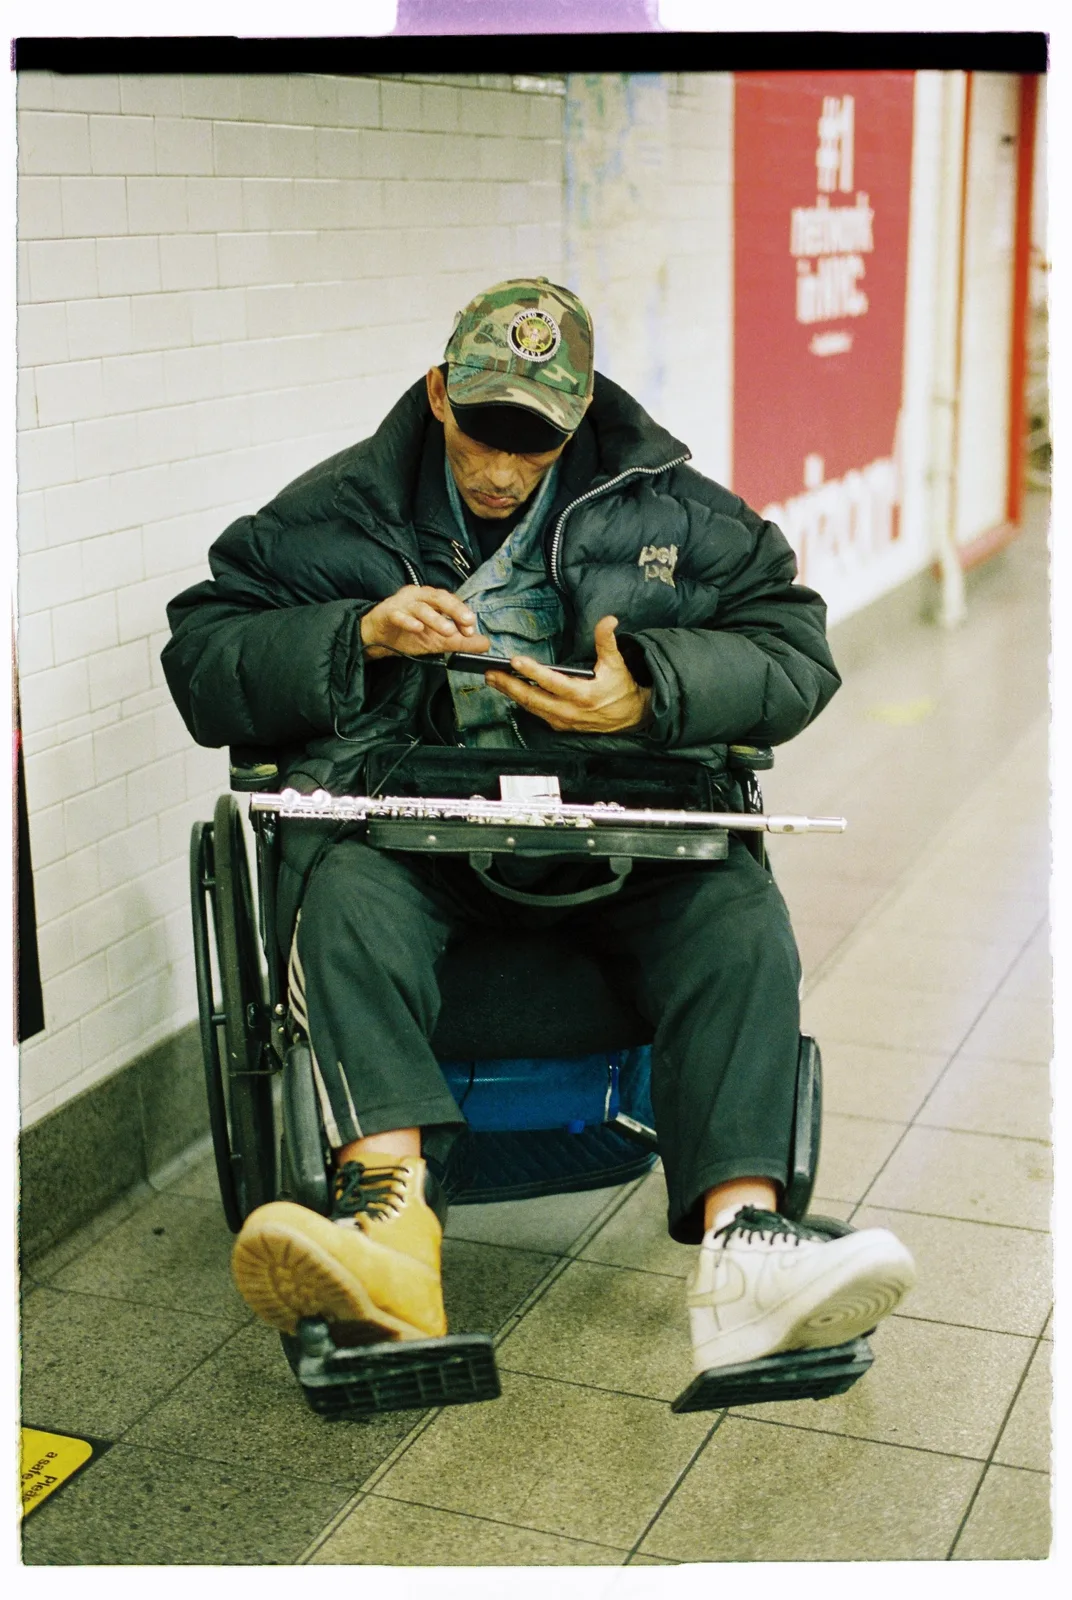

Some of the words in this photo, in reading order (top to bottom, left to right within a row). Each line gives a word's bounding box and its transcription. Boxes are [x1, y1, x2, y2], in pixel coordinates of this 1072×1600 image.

[815, 94, 855, 193] #1
[790, 190, 875, 256] network
[45, 1451, 58, 1460] a
